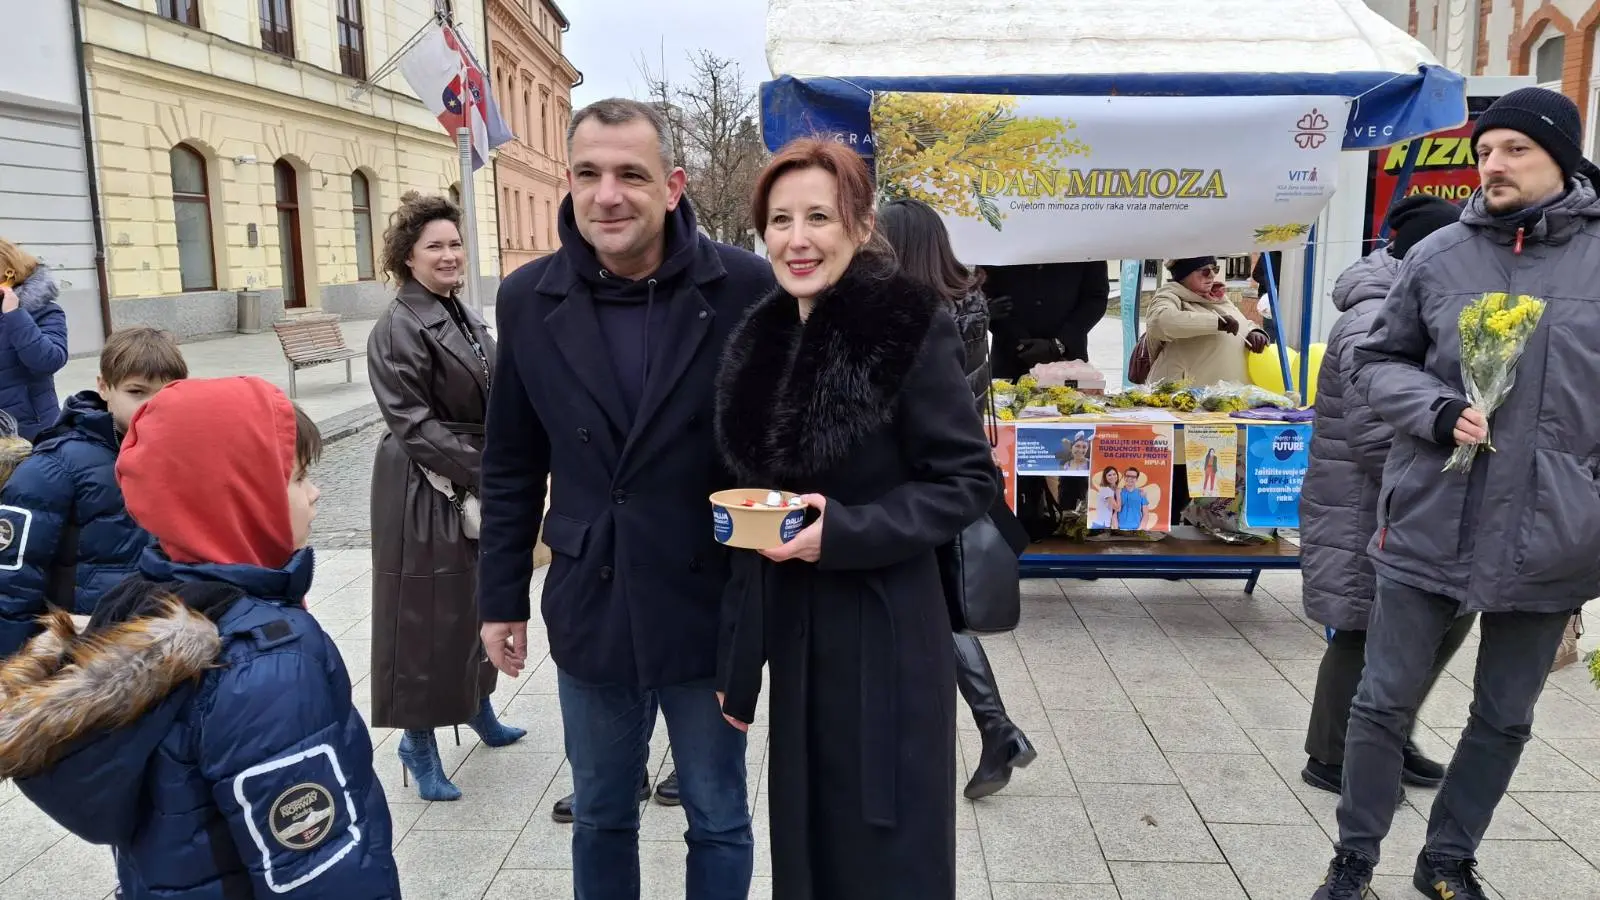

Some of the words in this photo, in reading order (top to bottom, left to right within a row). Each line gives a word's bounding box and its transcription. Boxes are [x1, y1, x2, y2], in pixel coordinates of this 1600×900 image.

[1344, 125, 1393, 138] VEC
[979, 168, 1061, 197] DAN
[1064, 167, 1228, 199] MIMOZA
[1404, 184, 1472, 200] ASINO
[1010, 201, 1046, 212] Cvijetom
[1047, 202, 1080, 211] mimoza
[1081, 202, 1106, 212] protiv
[1106, 202, 1124, 211] raka
[1126, 202, 1147, 211] vrata
[1148, 202, 1190, 211] maternice
[1273, 441, 1304, 451] FUTURE
[280, 792, 318, 818] NORWAY
